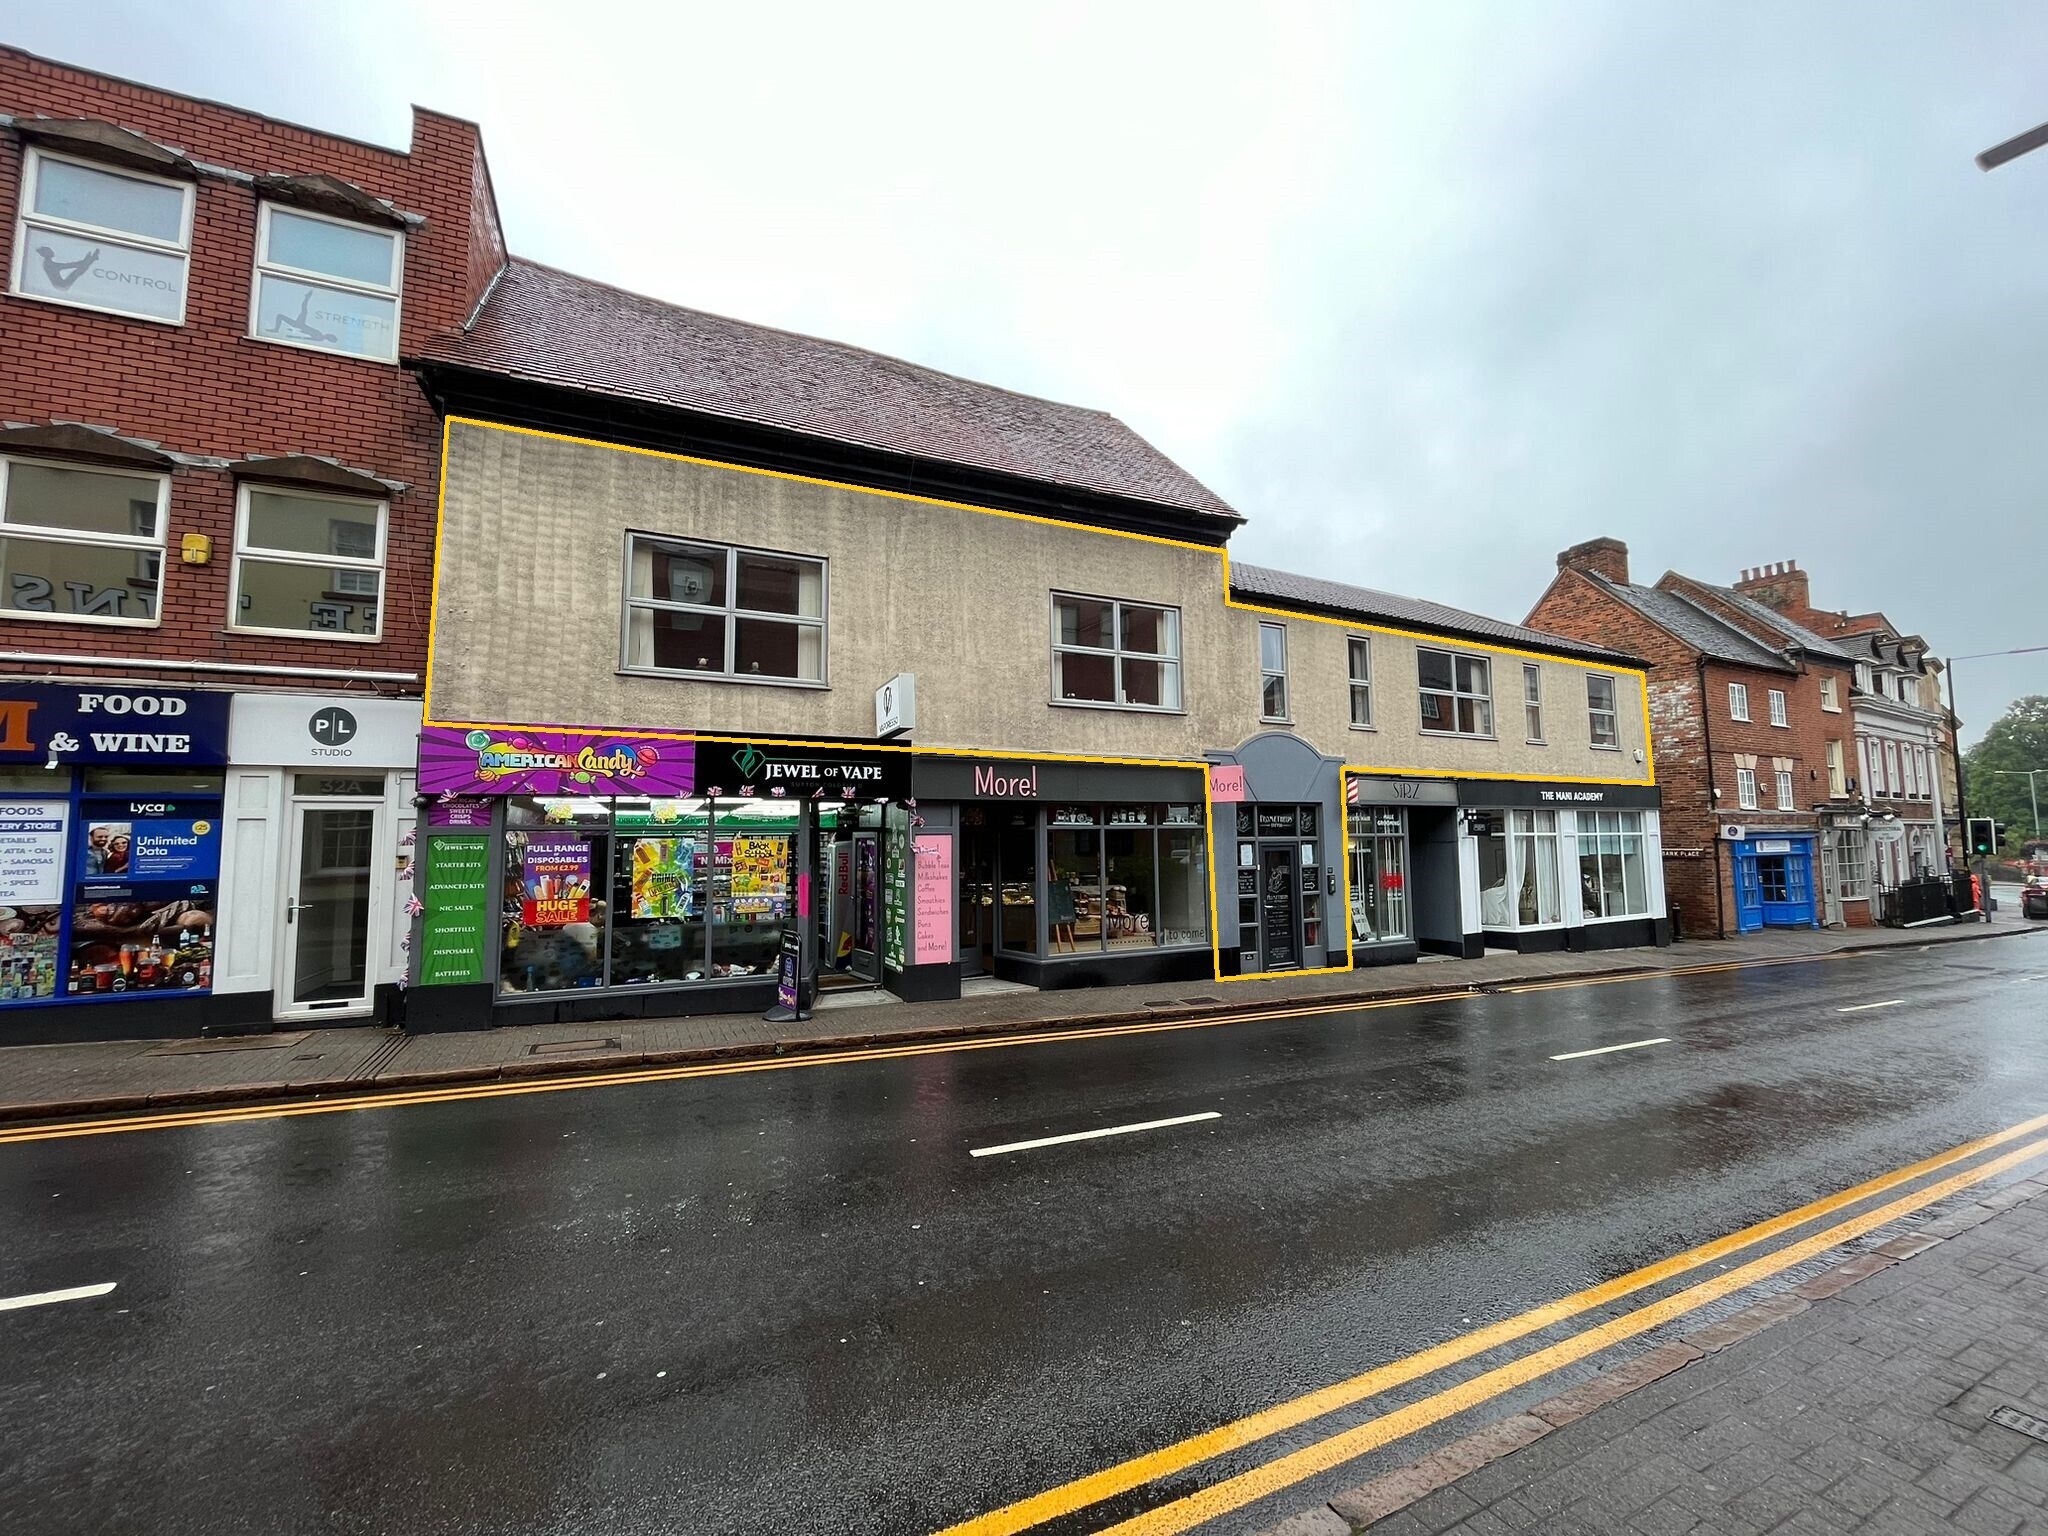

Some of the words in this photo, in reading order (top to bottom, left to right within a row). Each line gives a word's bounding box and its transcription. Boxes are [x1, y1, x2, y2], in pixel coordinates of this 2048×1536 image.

[93, 268, 177, 293] CONTROL
[315, 310, 390, 331] STRENGTH
[78, 694, 187, 716] FOOD
[49, 732, 79, 752] &
[90, 733, 190, 752] WINE
[311, 749, 352, 757] STUDIO
[481, 753, 580, 769] AMERICAN
[578, 746, 646, 777] Candy
[765, 763, 821, 780] JEWEL
[824, 768, 838, 777] OF
[841, 765, 882, 780] VAPE
[975, 765, 1037, 797] More!
[1210, 776, 1243, 792] More!
[321, 780, 362, 793] 32A
[1540, 791, 1554, 800] THE
[1555, 791, 1572, 800] MANI
[1573, 791, 1604, 801] ACADEMY
[130, 802, 165, 813] Lyca
[23, 822, 57, 830] STORE
[137, 836, 198, 845] Unlimited
[749, 841, 769, 850] BACK
[136, 846, 168, 856] Data
[527, 845, 550, 853] FULL
[554, 844, 588, 852] RANGE
[744, 849, 774, 858] SCHOOL
[1680, 850, 1700, 858] PLACE
[527, 856, 588, 864] DISPOSABLES
[918, 860, 936, 869] Bubble
[652, 873, 675, 883] PRIME
[918, 871, 948, 881] Milkshakes
[917, 895, 945, 905] Smoothies
[537, 900, 578, 911] HUGE
[917, 906, 949, 916] Sandwiches
[536, 911, 578, 923] SALE
[1108, 914, 1149, 933] More
[434, 926, 476, 934] SHORTFILLS
[1169, 930, 1179, 940] to
[1181, 929, 1205, 938] come
[917, 932, 934, 940] Cakes
[928, 942, 947, 951] More!
[435, 970, 471, 978] BATTERIES
